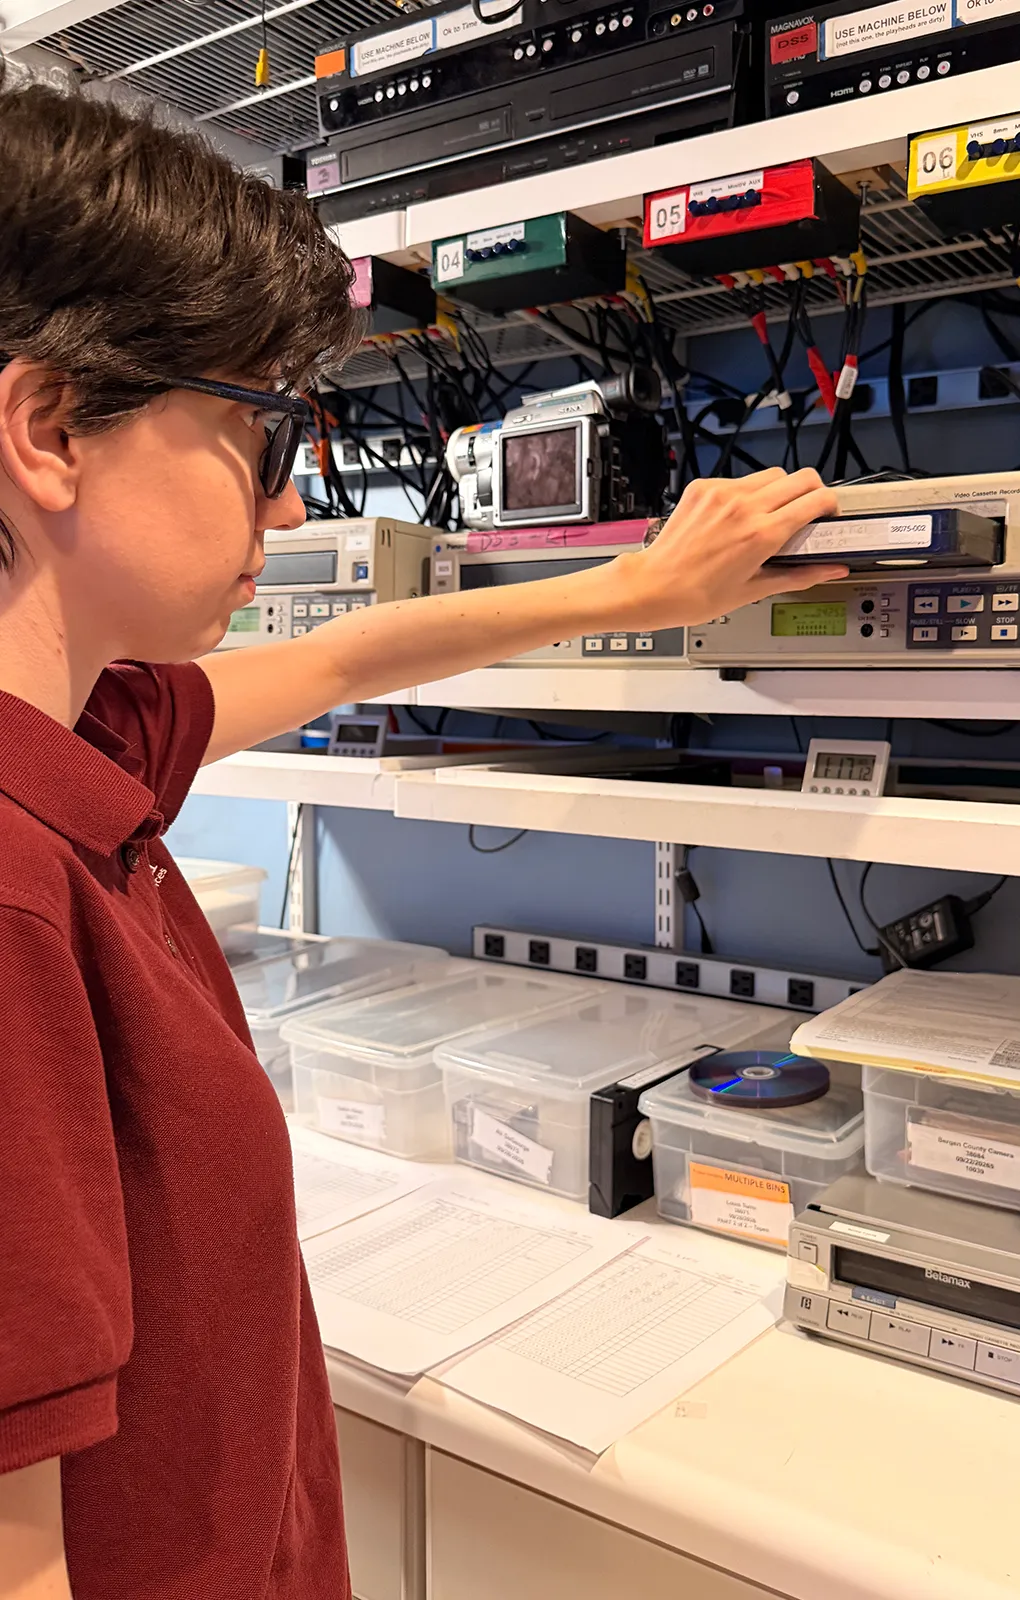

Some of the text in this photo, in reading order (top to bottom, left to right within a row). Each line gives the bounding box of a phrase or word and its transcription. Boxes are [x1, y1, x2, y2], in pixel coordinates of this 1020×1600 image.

[443, 19, 478, 36] Ok to Time
[770, 15, 816, 35] MAGNAVOX
[835, 3, 947, 40] USE MACHINE BELOW
[835, 41, 848, 49] (not
[849, 37, 860, 45] this
[875, 31, 885, 39] the
[885, 23, 916, 37] playheads
[928, 15, 945, 24] dirty)
[361, 50, 375, 60] USE
[376, 39, 405, 55] MACHINE
[406, 32, 430, 46] BELOW
[830, 87, 854, 98] HDMI
[922, 147, 954, 173] 06
[749, 178, 761, 186] AUX
[656, 205, 681, 228] 05
[441, 251, 461, 272] 04
[954, 491, 971, 499] Video
[972, 490, 998, 498] Cassette
[890, 524, 926, 533] 38075-002
[938, 1136, 1014, 1158] Bergen County Camera
[724, 1173, 764, 1189] MULTIPLE
[766, 1182, 786, 1194] BINS
[925, 1268, 971, 1289] Betamax
[997, 1354, 1013, 1363] STOP
